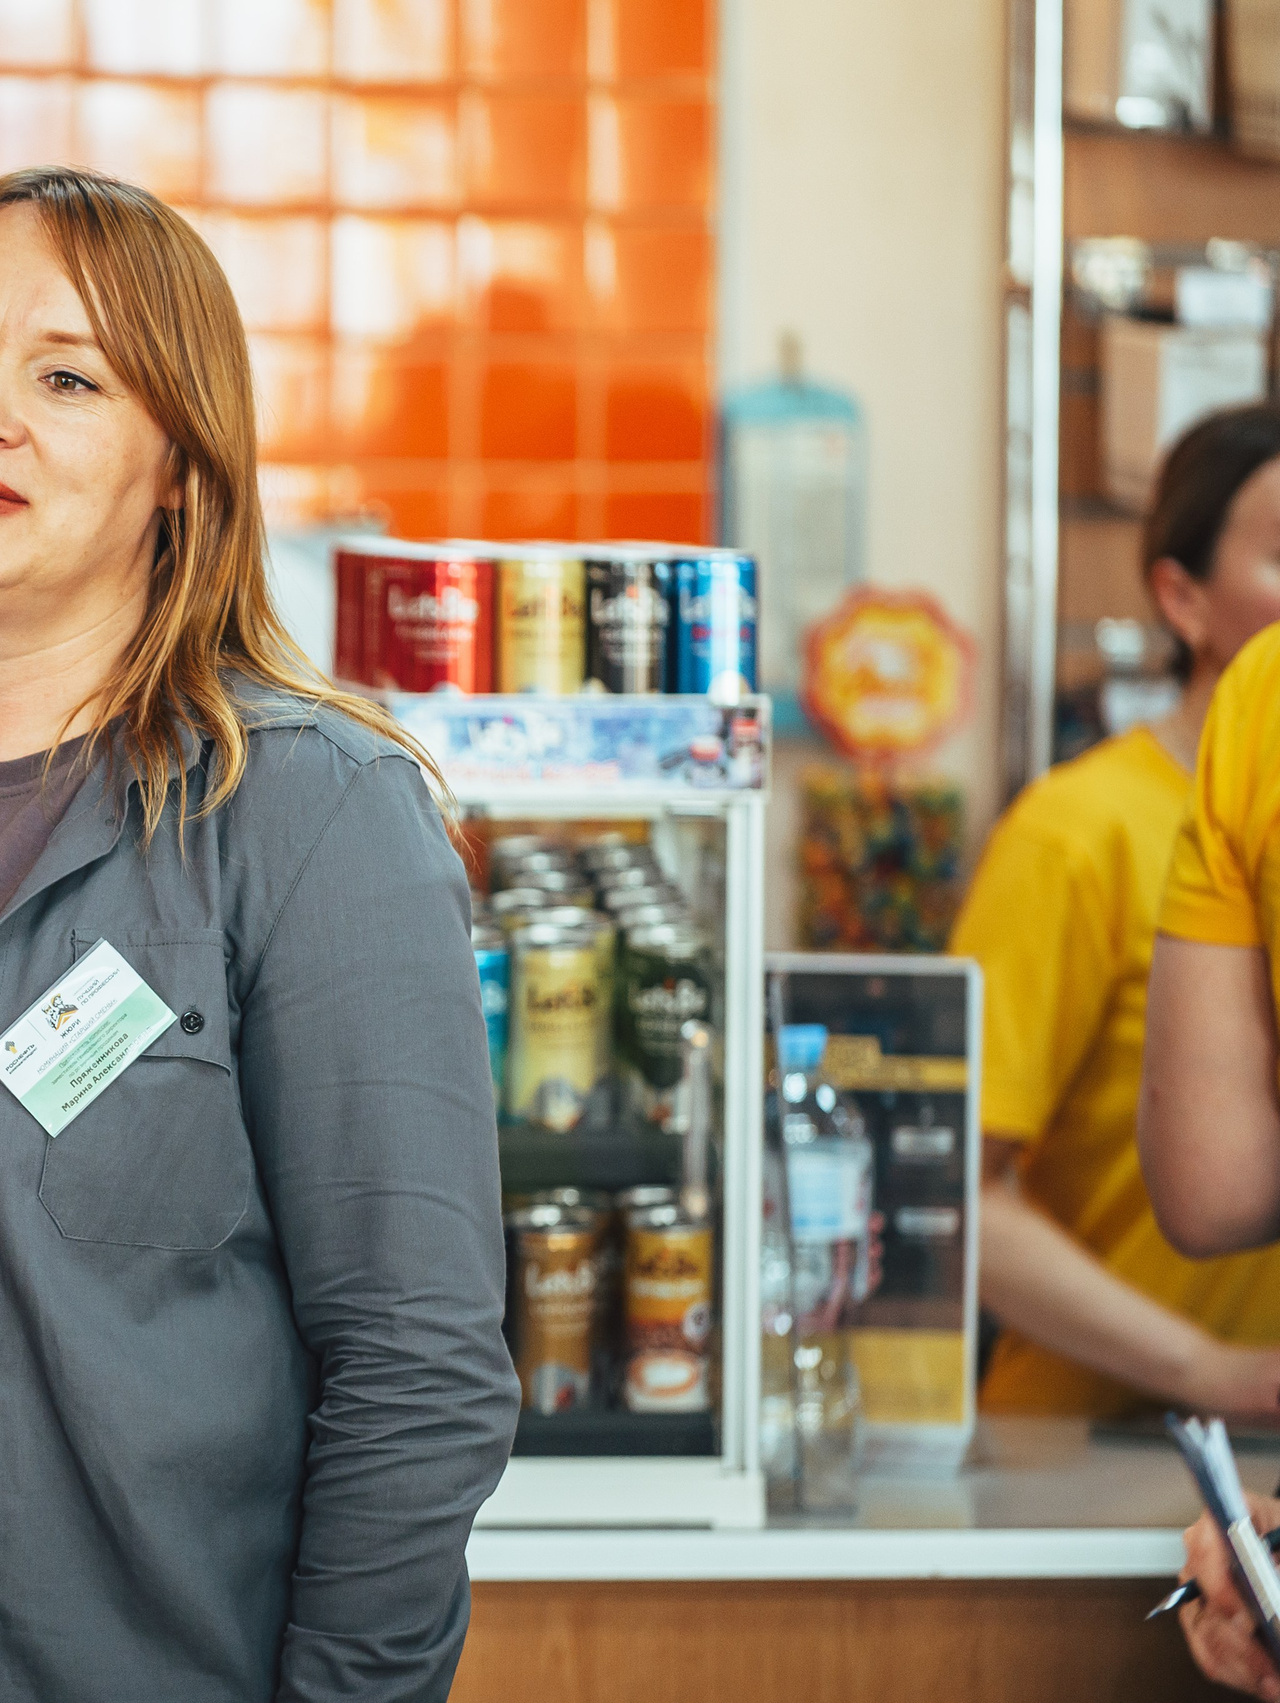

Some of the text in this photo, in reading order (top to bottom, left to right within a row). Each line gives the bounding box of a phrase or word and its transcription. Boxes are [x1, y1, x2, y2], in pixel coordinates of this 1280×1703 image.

[60, 1018, 81, 1039] ЖЮРИ
[5, 1044, 35, 1072] РОСНЕФТЬ
[37, 1042, 69, 1074] НОМИНАЦИЯ
[61, 1027, 151, 1112] Марина Александ
[69, 1032, 129, 1088] Пряженникова
